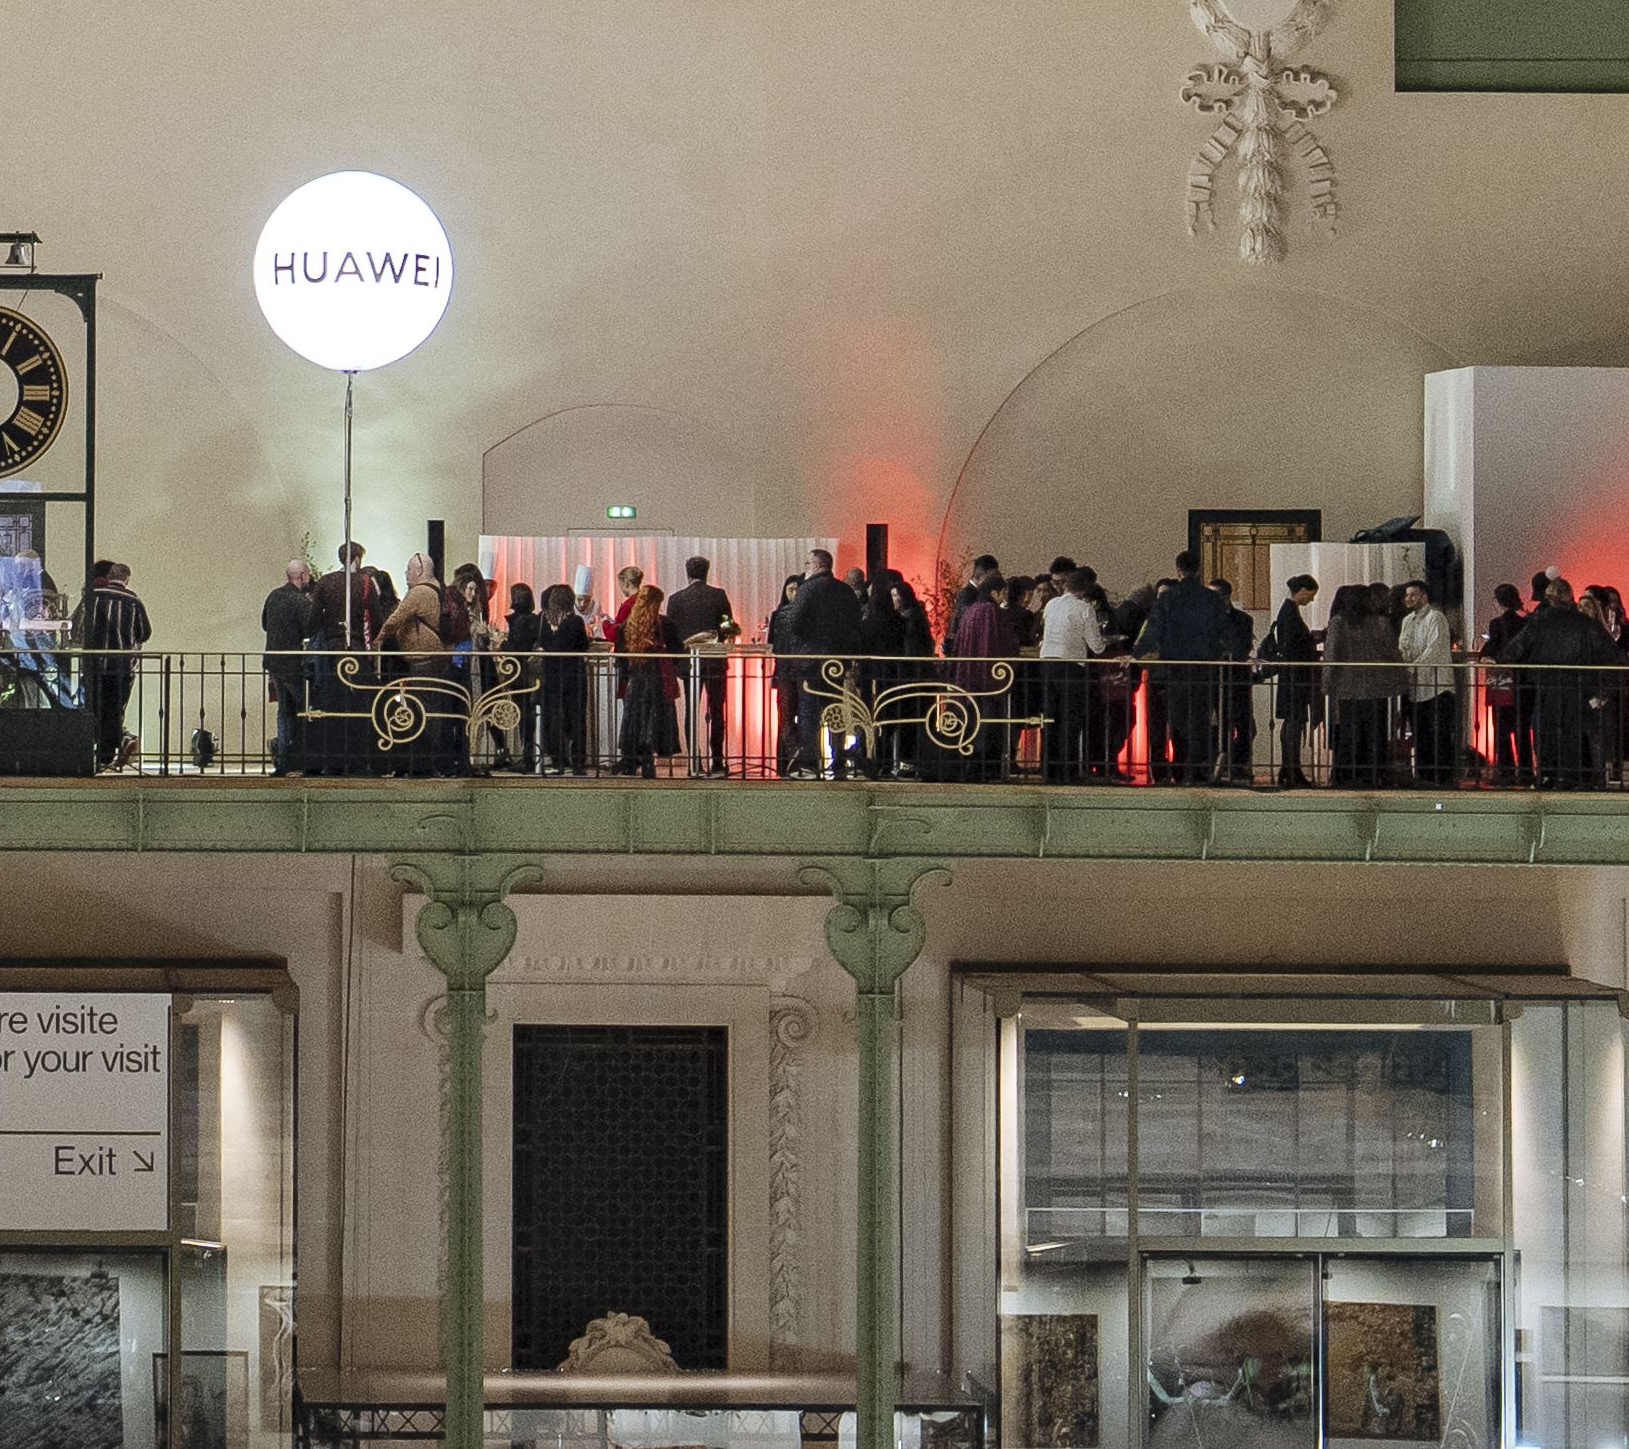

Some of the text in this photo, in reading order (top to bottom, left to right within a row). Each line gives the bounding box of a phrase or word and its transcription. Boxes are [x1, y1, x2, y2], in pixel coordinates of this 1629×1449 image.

[274, 251, 440, 289] HUAWEI
[37, 1005, 119, 1035] visite
[23, 1047, 94, 1080] your
[101, 1043, 162, 1074] visit
[53, 1145, 118, 1177] Exit
